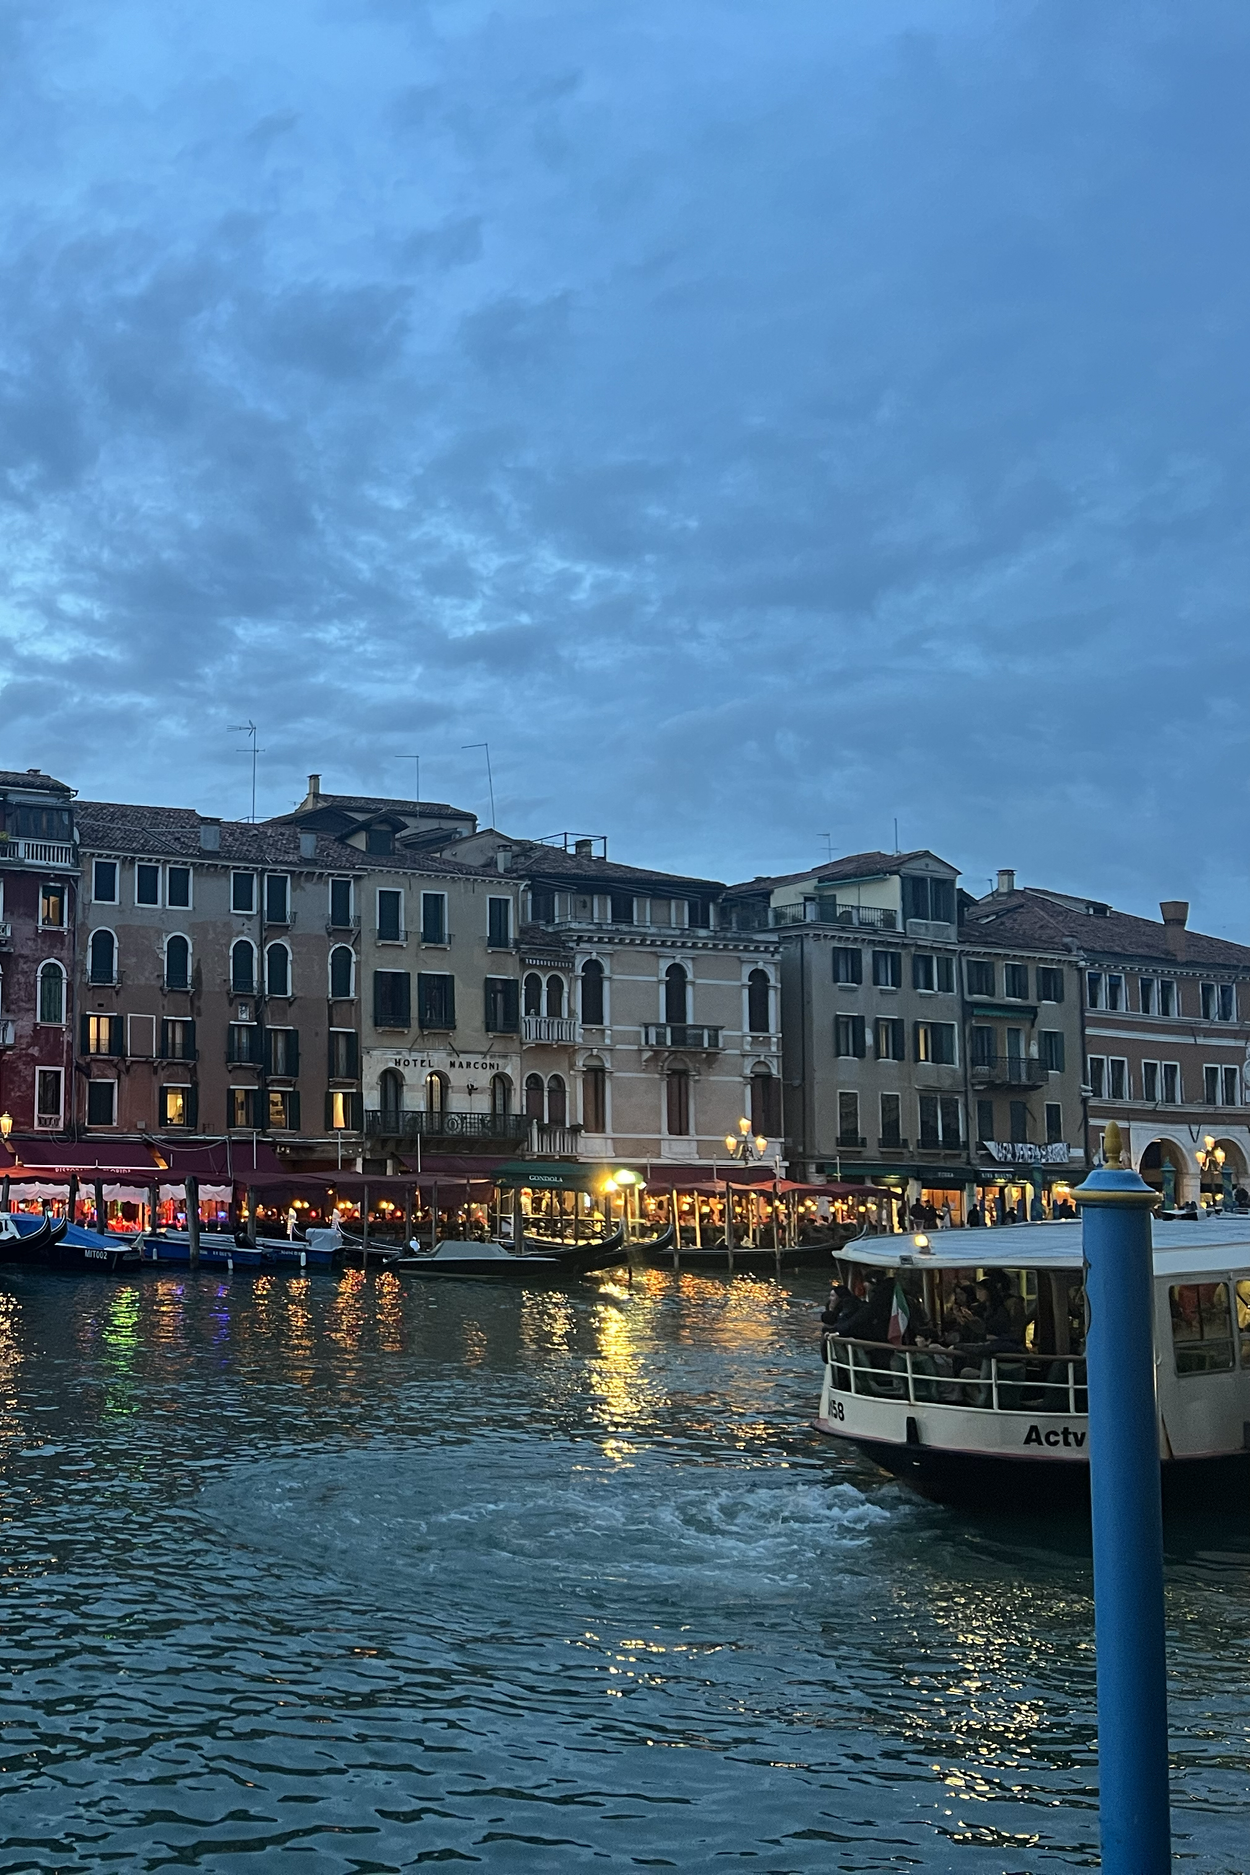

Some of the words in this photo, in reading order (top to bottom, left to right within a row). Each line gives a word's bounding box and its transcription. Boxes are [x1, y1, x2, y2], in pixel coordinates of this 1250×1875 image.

[394, 1058, 434, 1068] HOTEL
[449, 1060, 500, 1070] MARCONI
[528, 1174, 563, 1183] GONDOLA
[1023, 1425, 1086, 1447] Actv
